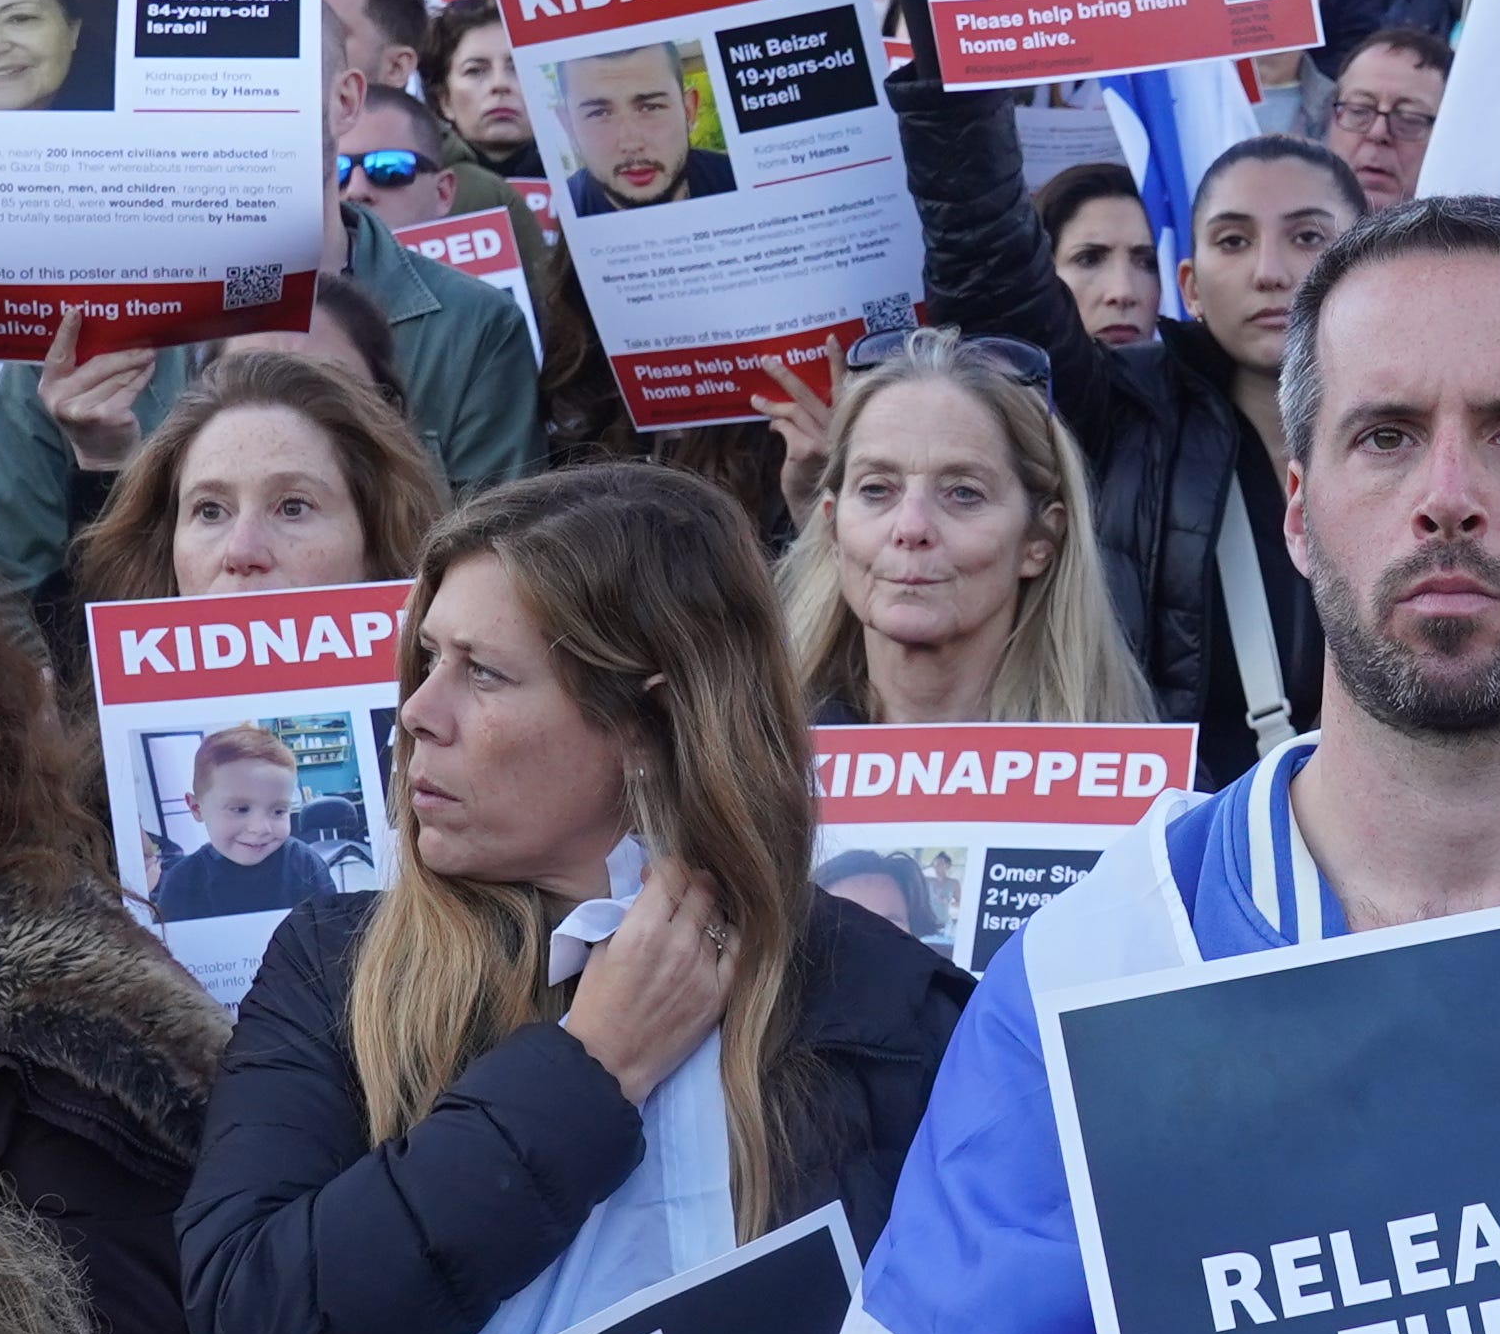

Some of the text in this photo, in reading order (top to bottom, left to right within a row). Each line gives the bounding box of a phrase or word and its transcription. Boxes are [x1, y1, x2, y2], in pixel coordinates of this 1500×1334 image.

[148, 4, 268, 21] 84-years-old
[956, 10, 1024, 31] Please
[1029, 7, 1073, 26] help
[1078, 0, 1131, 20] bring
[147, 20, 207, 35] Israeli
[728, 30, 827, 65] Nik Beizer
[960, 31, 1075, 54] home alive.
[735, 48, 855, 89] 19-years-old
[211, 86, 280, 99] by Hamas
[740, 85, 802, 112] Israeli
[4, 299, 53, 318] help
[126, 298, 182, 315] them
[118, 608, 400, 675] KIDNAP
[989, 863, 1045, 883] Omer
